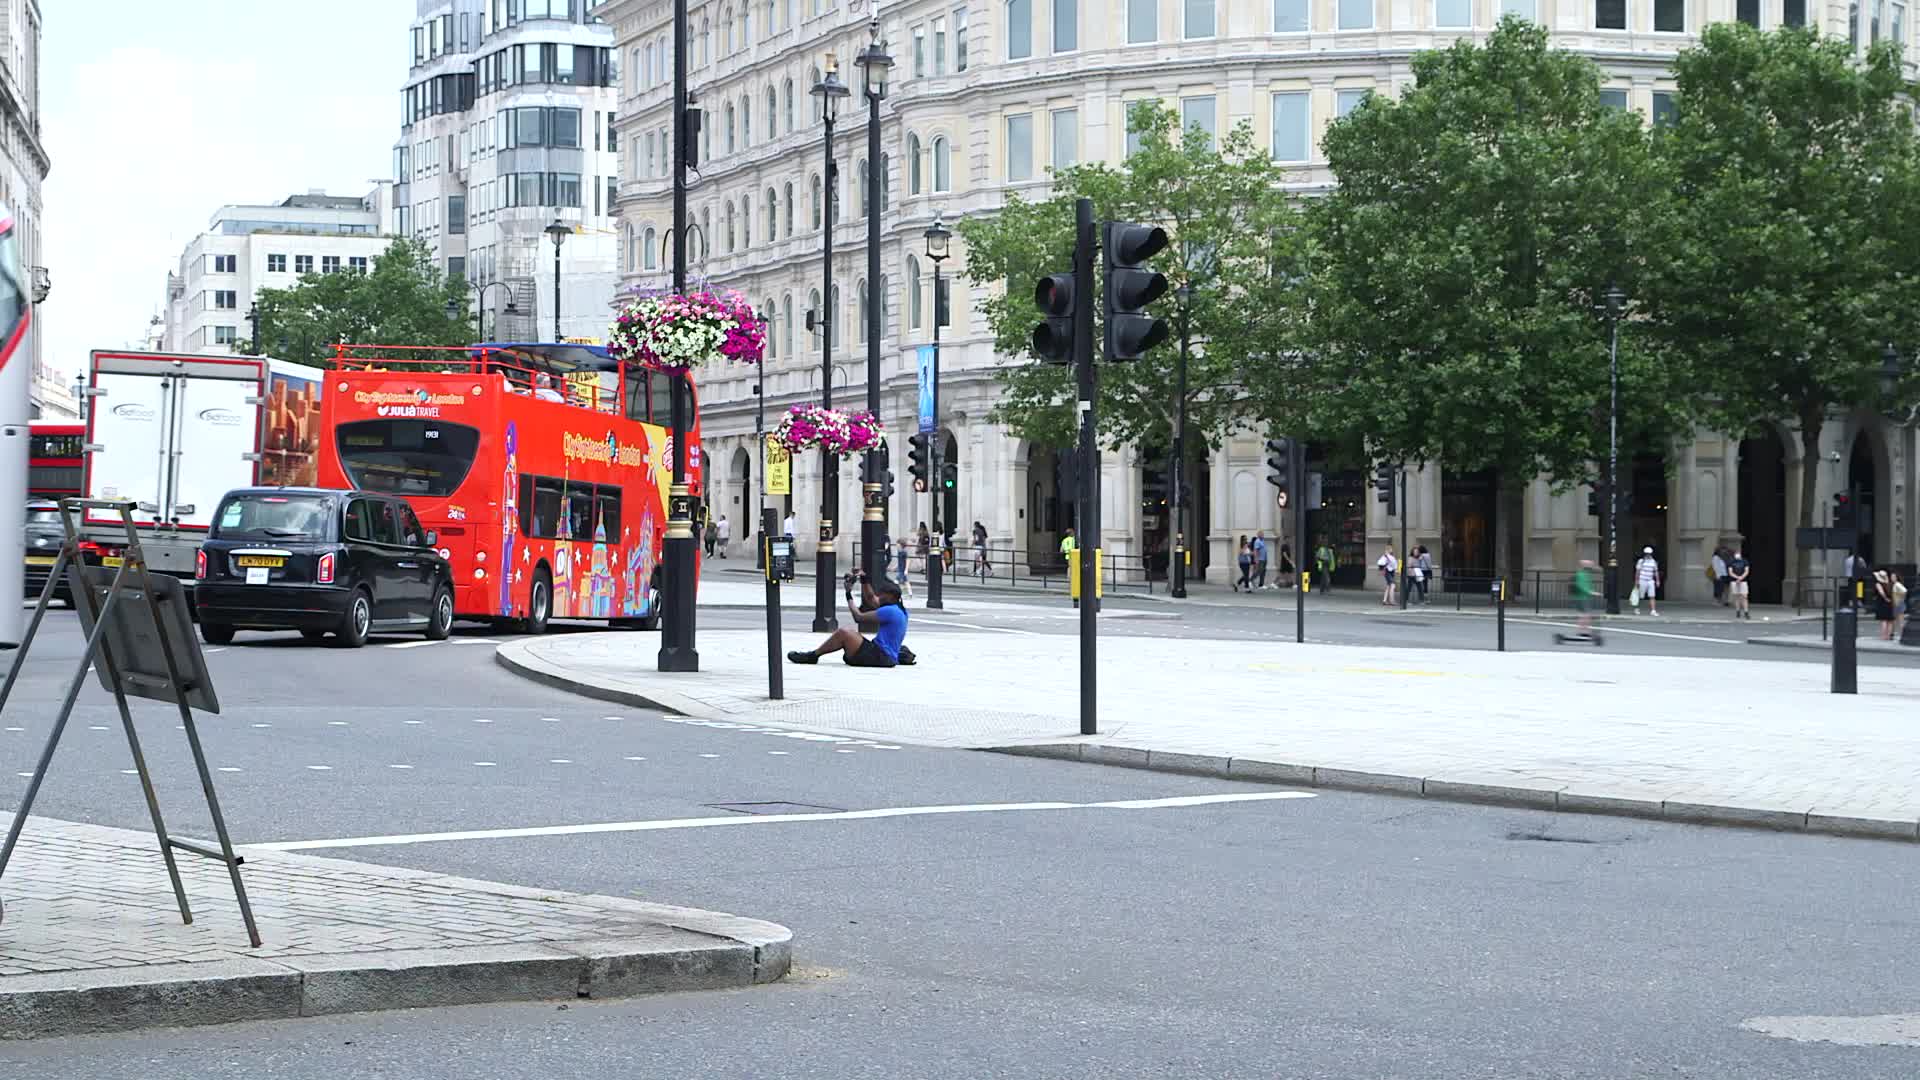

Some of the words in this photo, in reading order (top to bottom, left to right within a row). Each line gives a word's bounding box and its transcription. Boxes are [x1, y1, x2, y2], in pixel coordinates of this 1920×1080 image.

[432, 393, 465, 405] London
[417, 407, 440, 418] TRAVEL
[619, 440, 641, 467] London
